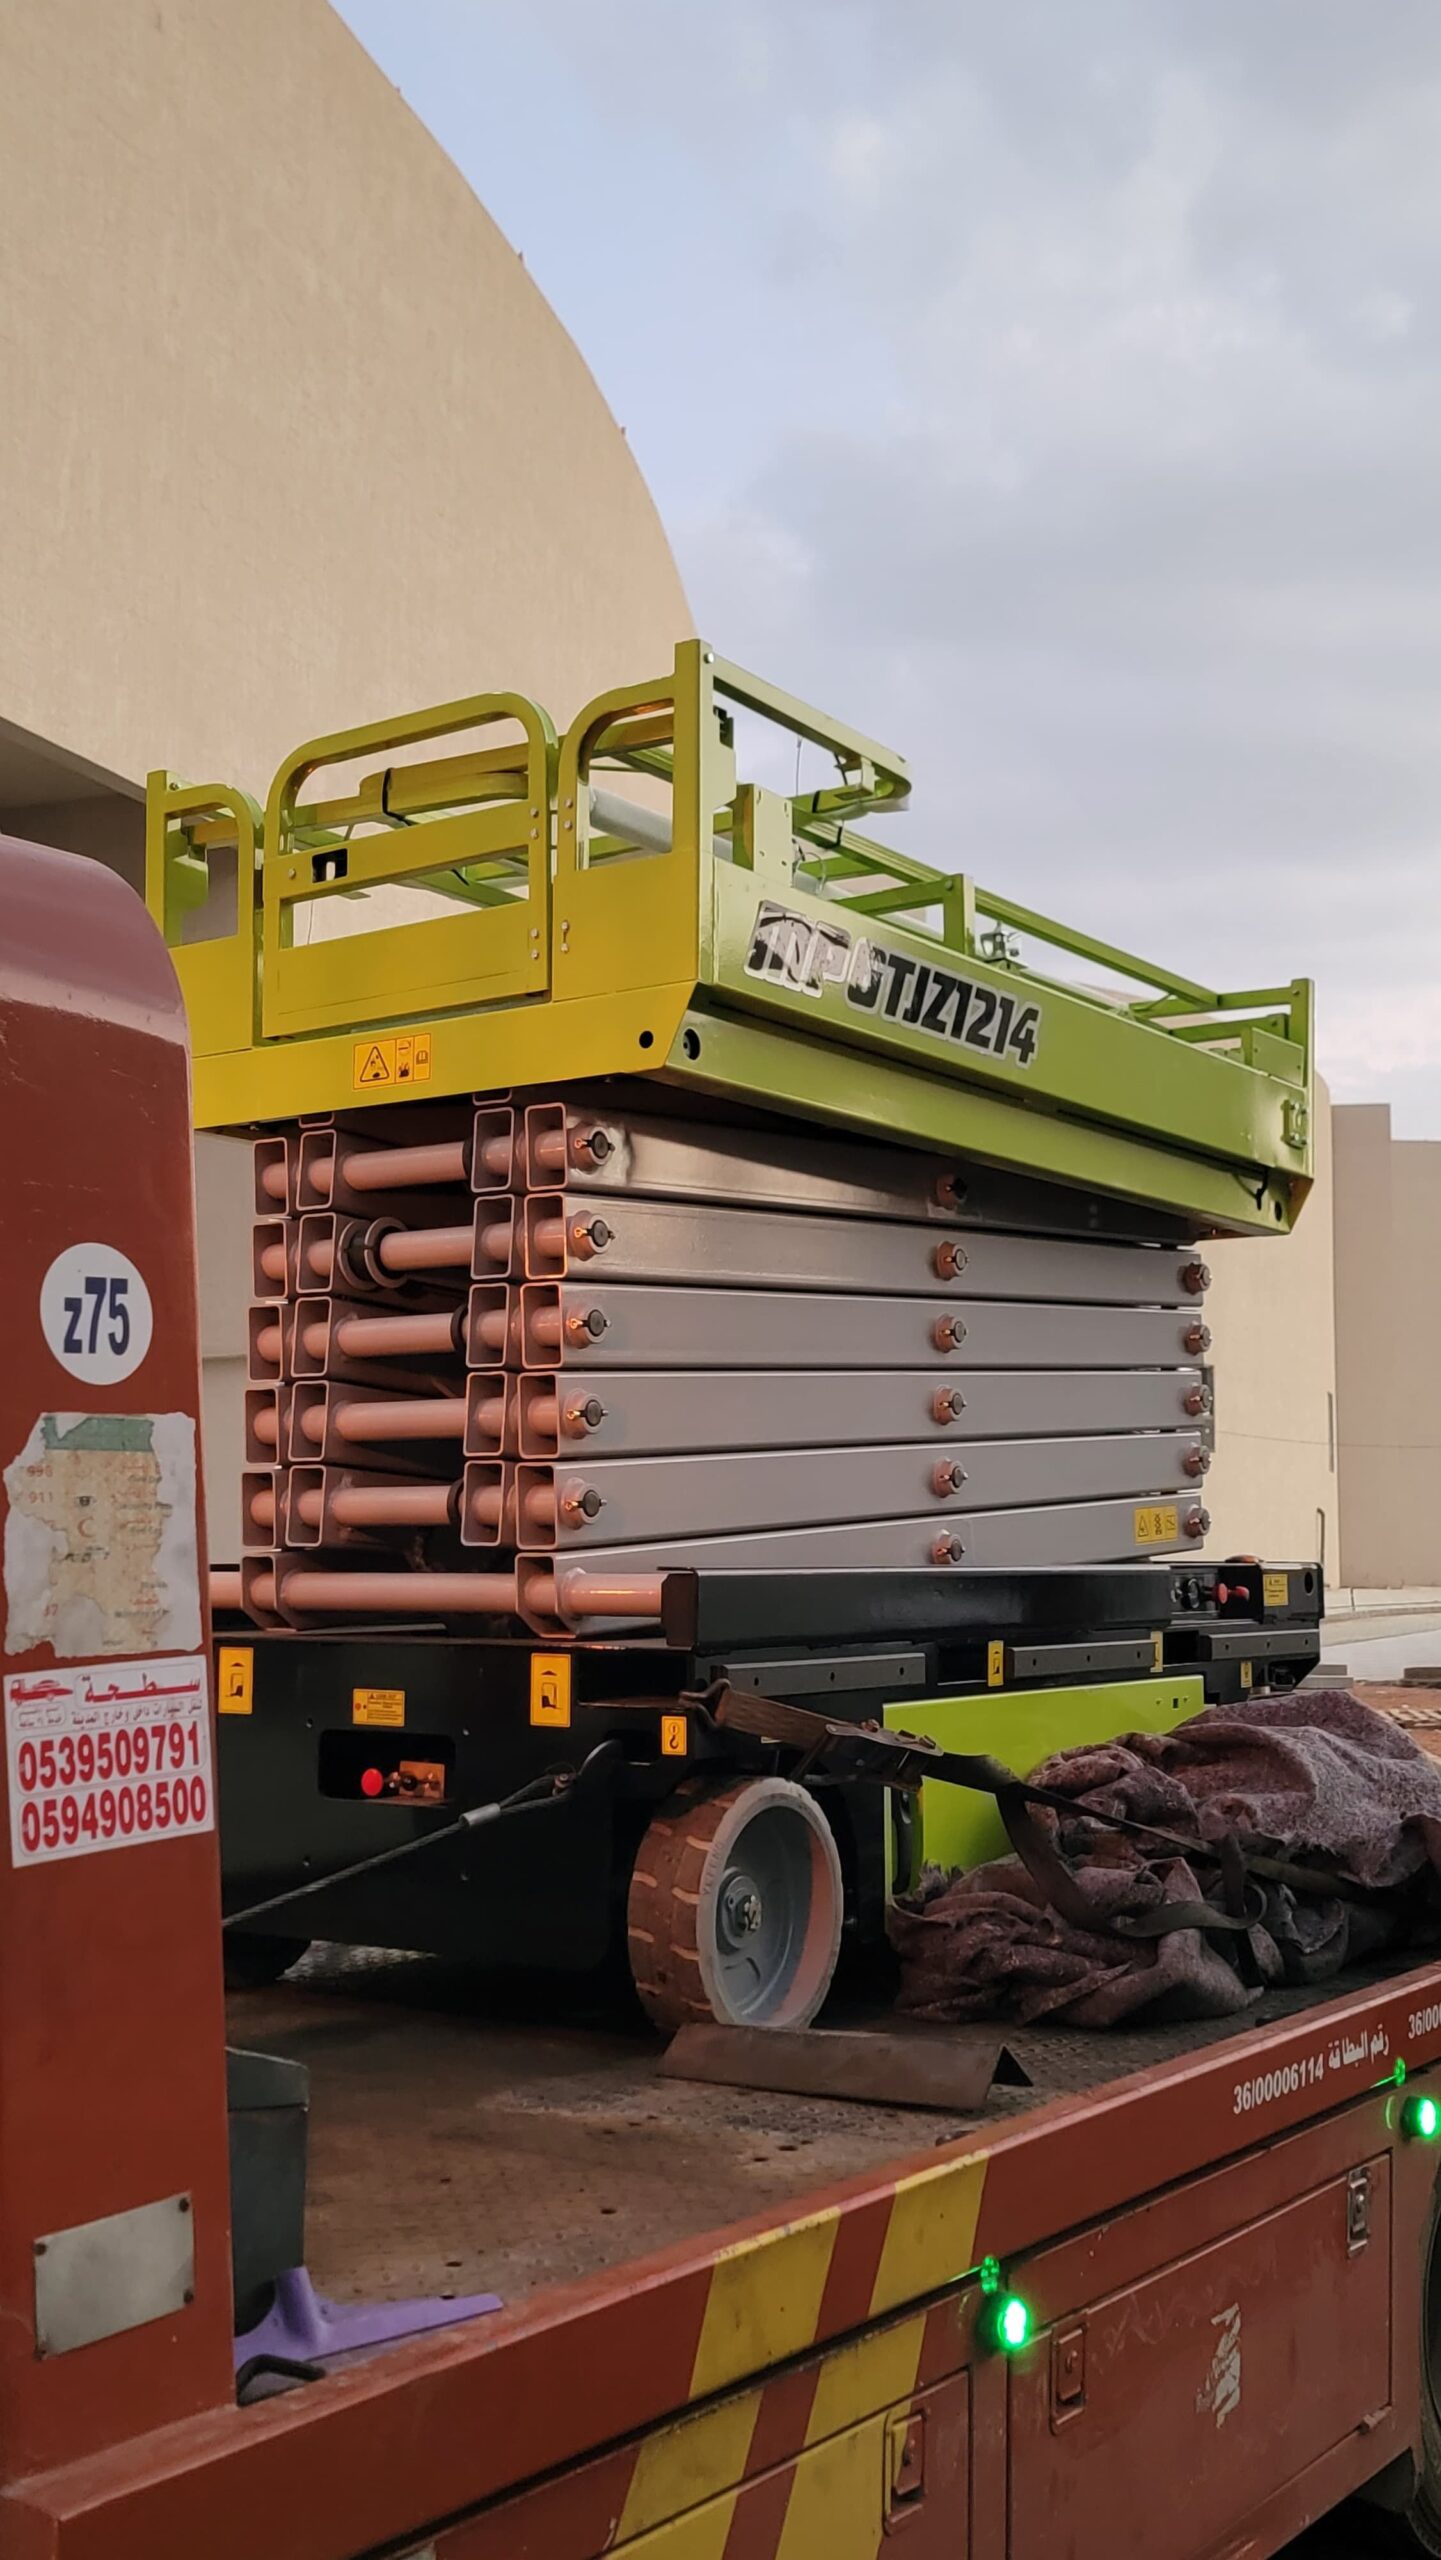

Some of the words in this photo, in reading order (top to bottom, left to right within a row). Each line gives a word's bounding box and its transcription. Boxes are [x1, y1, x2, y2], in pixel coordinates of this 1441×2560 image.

[82, 1672, 201, 1703] سطحة
[18, 1721, 200, 1791] 0539509791
[22, 1775, 206, 1852] 0594908500
[1327, 2029, 1368, 2069] البطاقة
[1370, 2023, 1390, 2065] رقم
